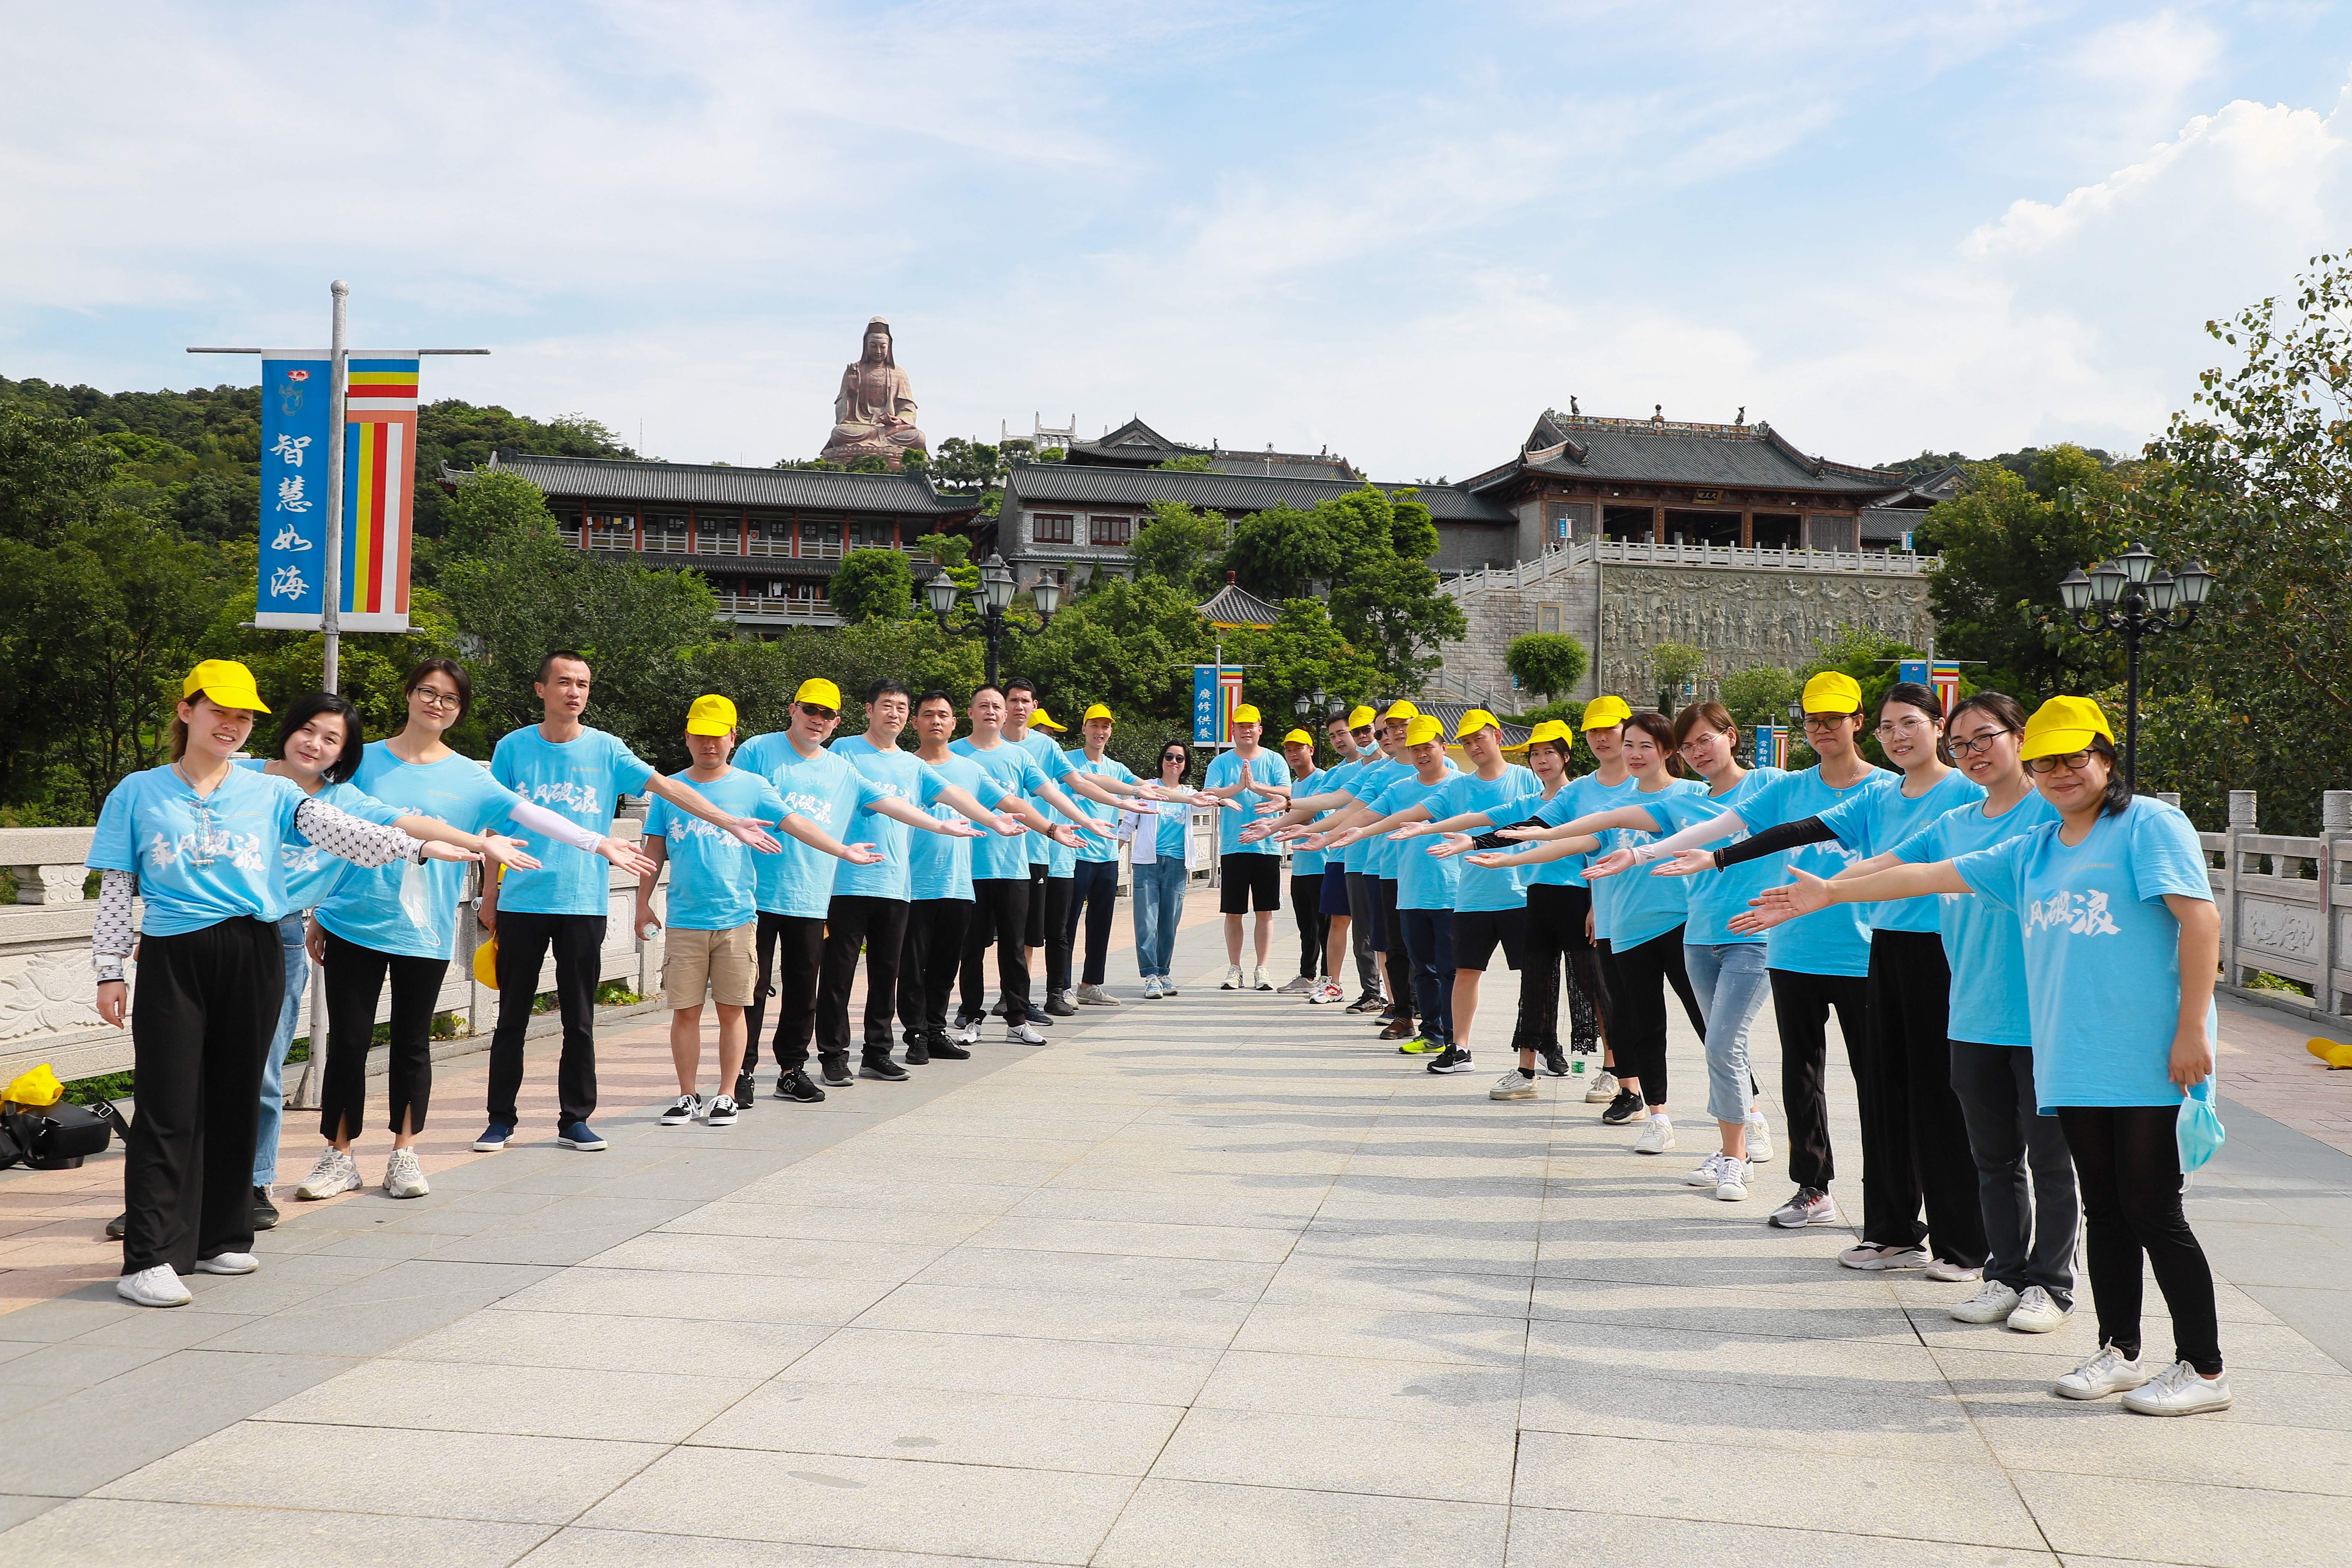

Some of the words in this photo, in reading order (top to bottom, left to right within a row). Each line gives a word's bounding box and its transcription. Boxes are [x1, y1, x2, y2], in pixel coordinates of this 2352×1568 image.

[270, 433, 313, 601] 智慧如海
[1197, 688, 1213, 739] 廣修供養
[775, 785, 832, 825] 风破浪
[2024, 889, 2121, 938] 风破浪
[783, 1079, 796, 1092] N
